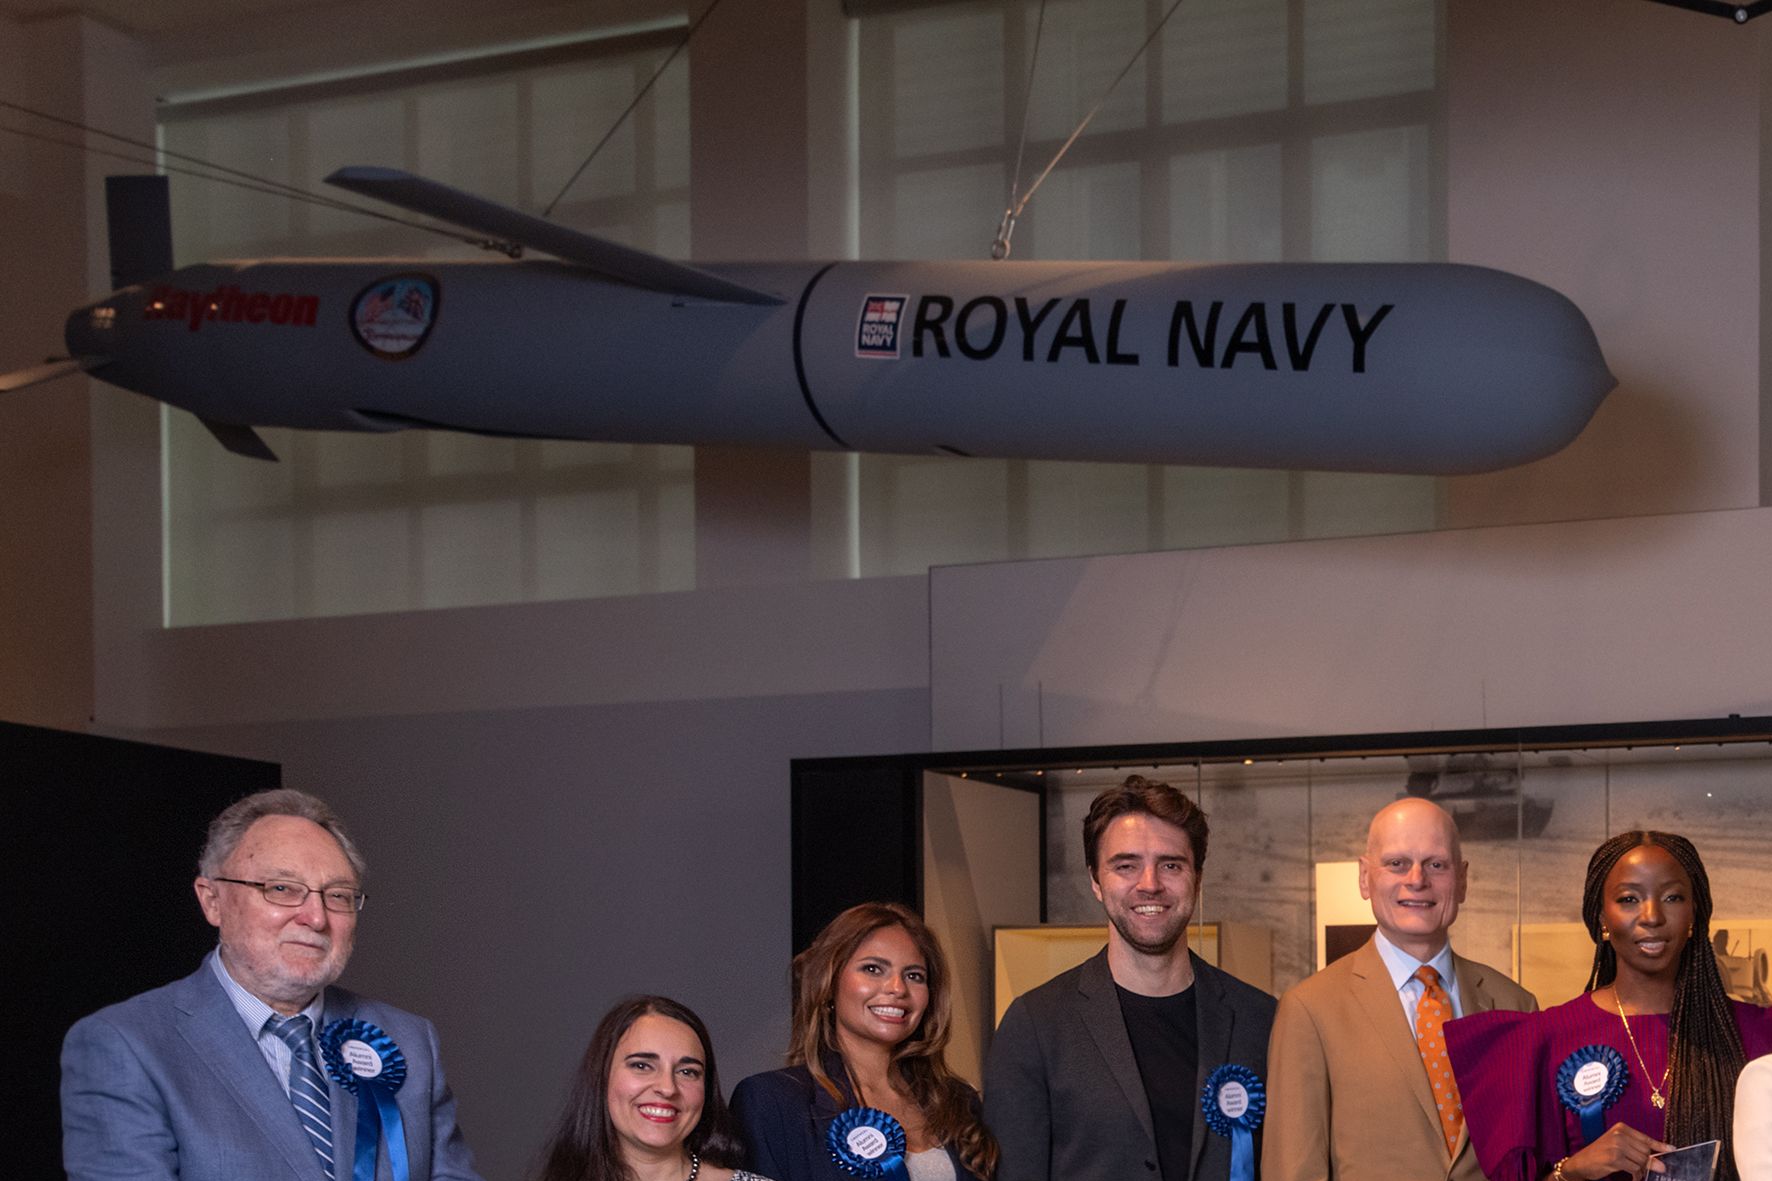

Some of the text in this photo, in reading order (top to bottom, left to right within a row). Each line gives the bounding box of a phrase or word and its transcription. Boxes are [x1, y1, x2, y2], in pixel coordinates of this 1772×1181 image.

[862, 323, 894, 335] ROYAL
[911, 294, 1396, 374] ROYAL NAVY
[861, 334, 893, 347] NAVY
[350, 1051, 372, 1060] Alumni
